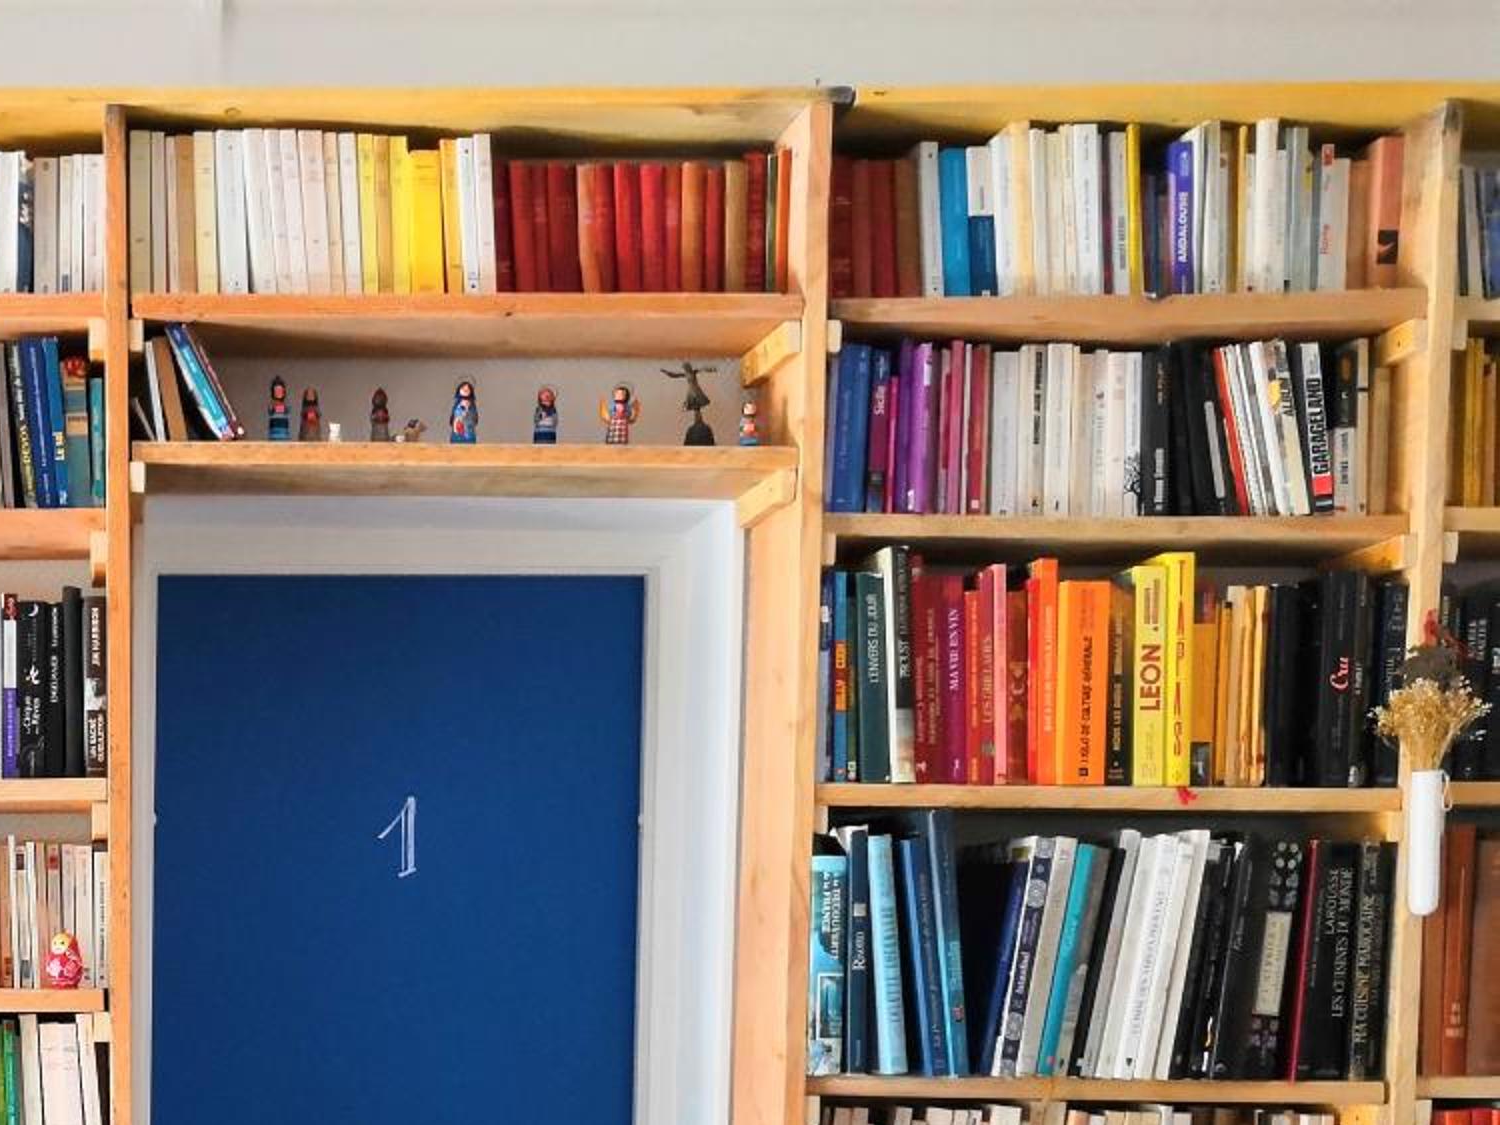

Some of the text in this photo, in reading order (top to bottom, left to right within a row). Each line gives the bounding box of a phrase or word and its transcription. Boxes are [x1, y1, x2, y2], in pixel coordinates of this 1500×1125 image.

[1176, 191, 1189, 263] ANDALOUSIE
[1304, 377, 1329, 476] GARAGELAND
[865, 593, 879, 621] JOUR
[866, 622, 879, 637] DU
[949, 608, 960, 629] VIN
[949, 669, 960, 691] MA
[1081, 684, 1092, 721] CULTURE
[1139, 643, 1162, 712] LEON
[1328, 655, 1349, 691] Cru
[377, 796, 417, 878] 1
[1324, 868, 1340, 935] LAROUSSE
[1330, 867, 1352, 1017] LES CUISINES DU MONDE
[1354, 895, 1375, 1043] MA CUISINE MAROCAINE
